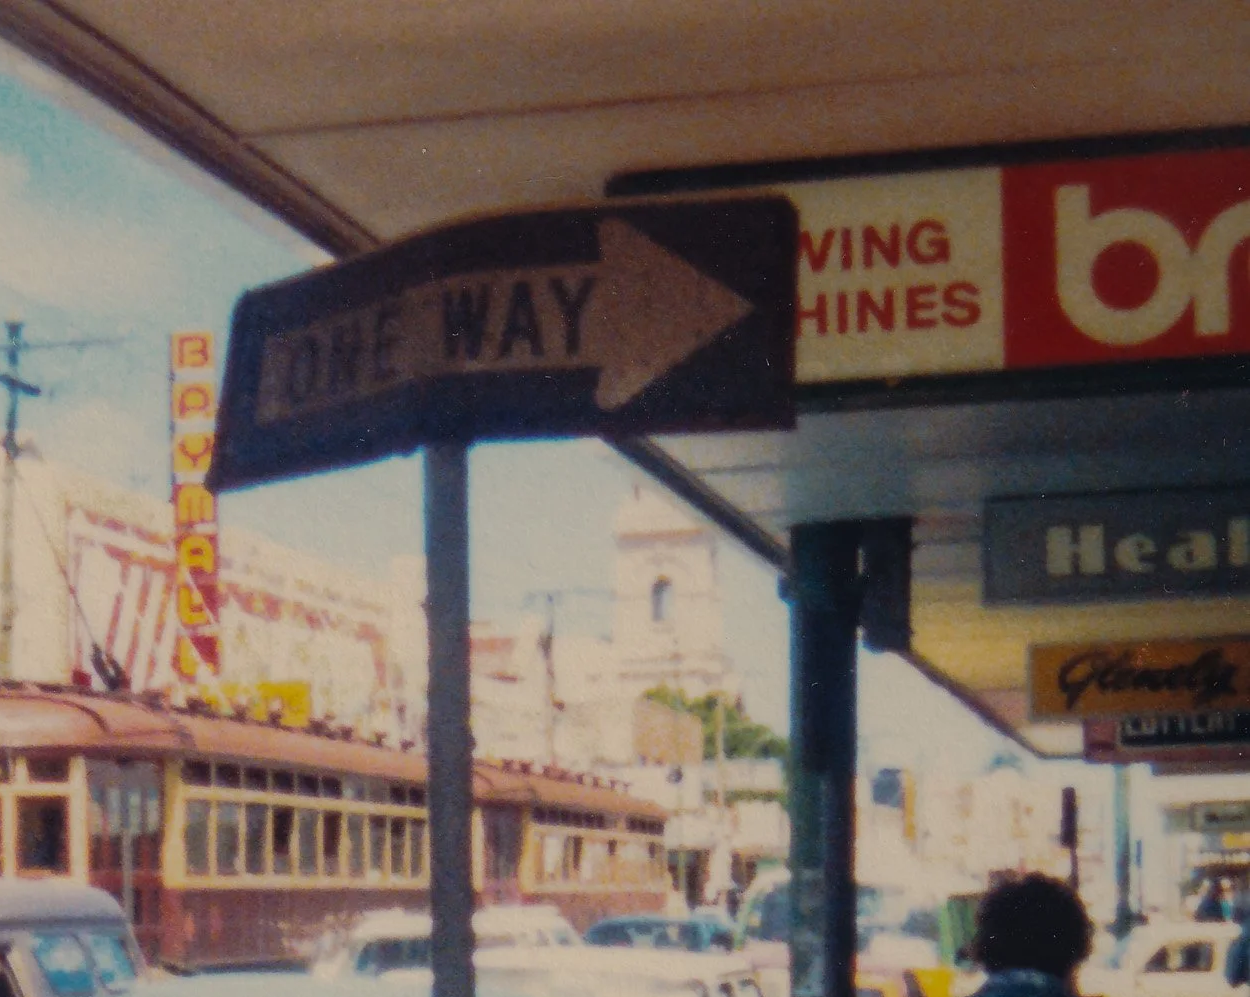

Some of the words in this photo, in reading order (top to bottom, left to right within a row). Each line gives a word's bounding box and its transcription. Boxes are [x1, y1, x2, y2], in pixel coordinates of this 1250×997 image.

[288, 307, 400, 400] ONE
[441, 276, 595, 362] WAY
[1046, 518, 1249, 577] Heal
